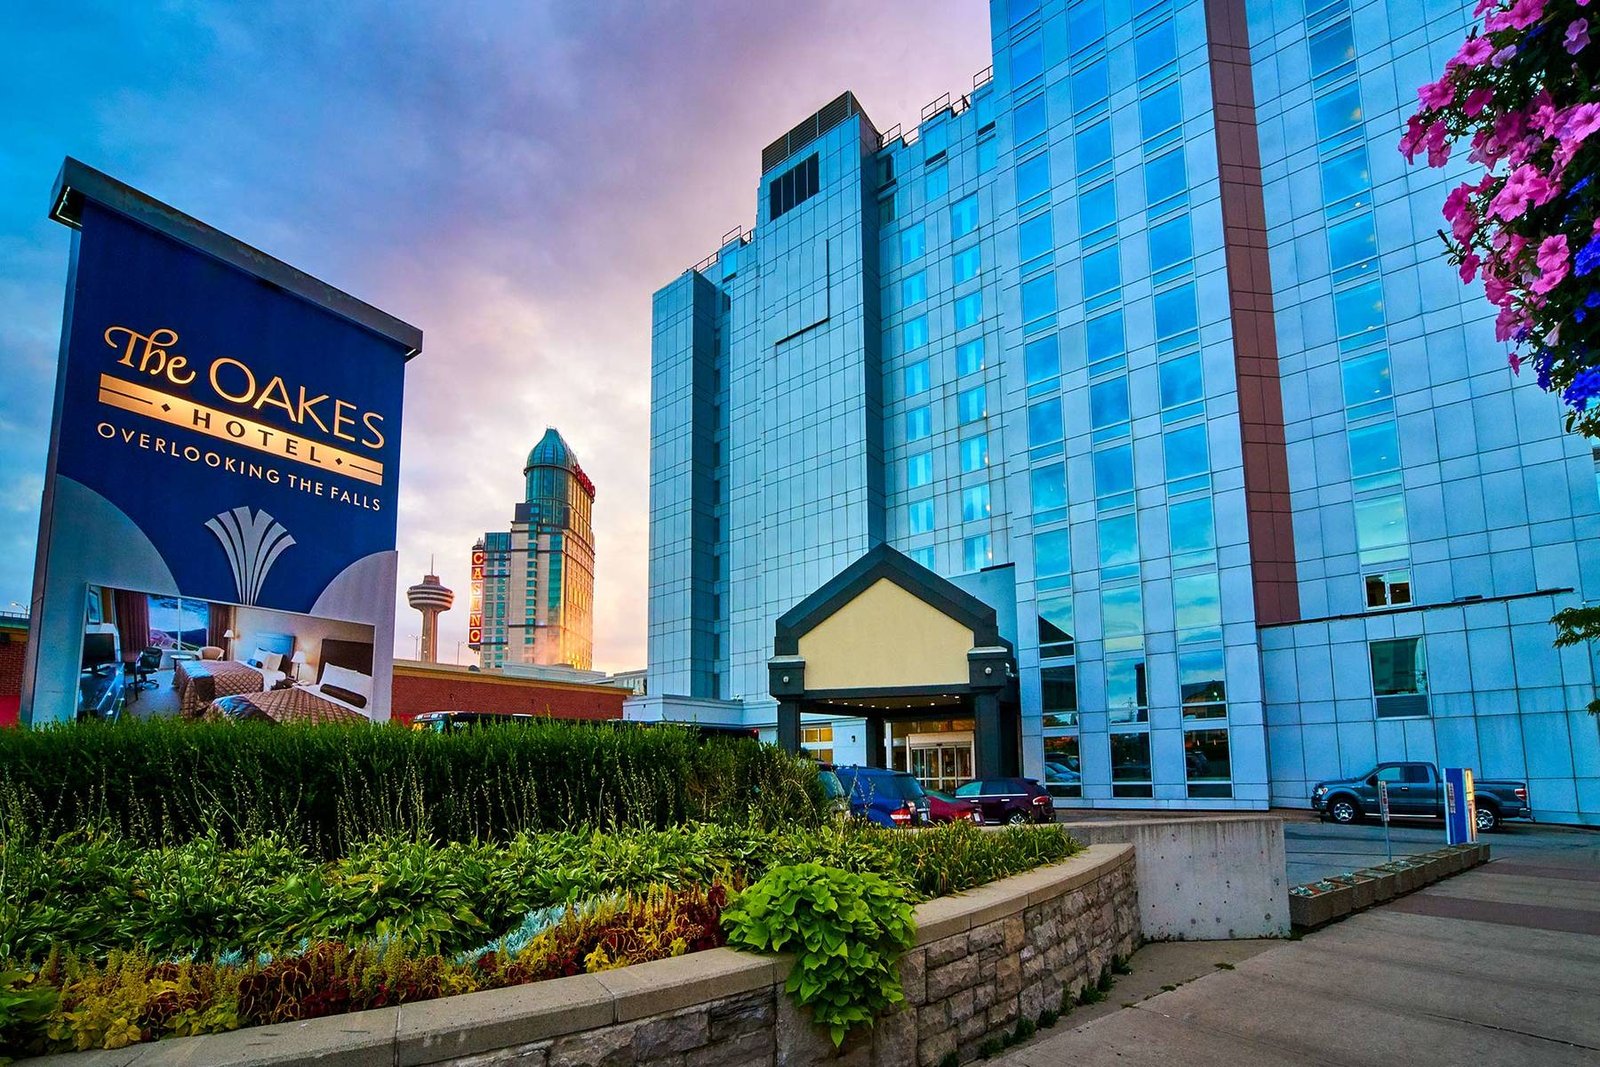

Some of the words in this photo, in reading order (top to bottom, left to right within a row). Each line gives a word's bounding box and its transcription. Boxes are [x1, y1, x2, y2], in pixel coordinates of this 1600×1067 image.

[104, 325, 196, 385] The
[209, 357, 385, 449] OAKES
[96, 422, 280, 484] OVERLOOKING
[287, 474, 323, 496] THE
[331, 487, 381, 512] FALLS
[192, 408, 321, 464] HOTEL
[470, 552, 484, 642] CASINO
